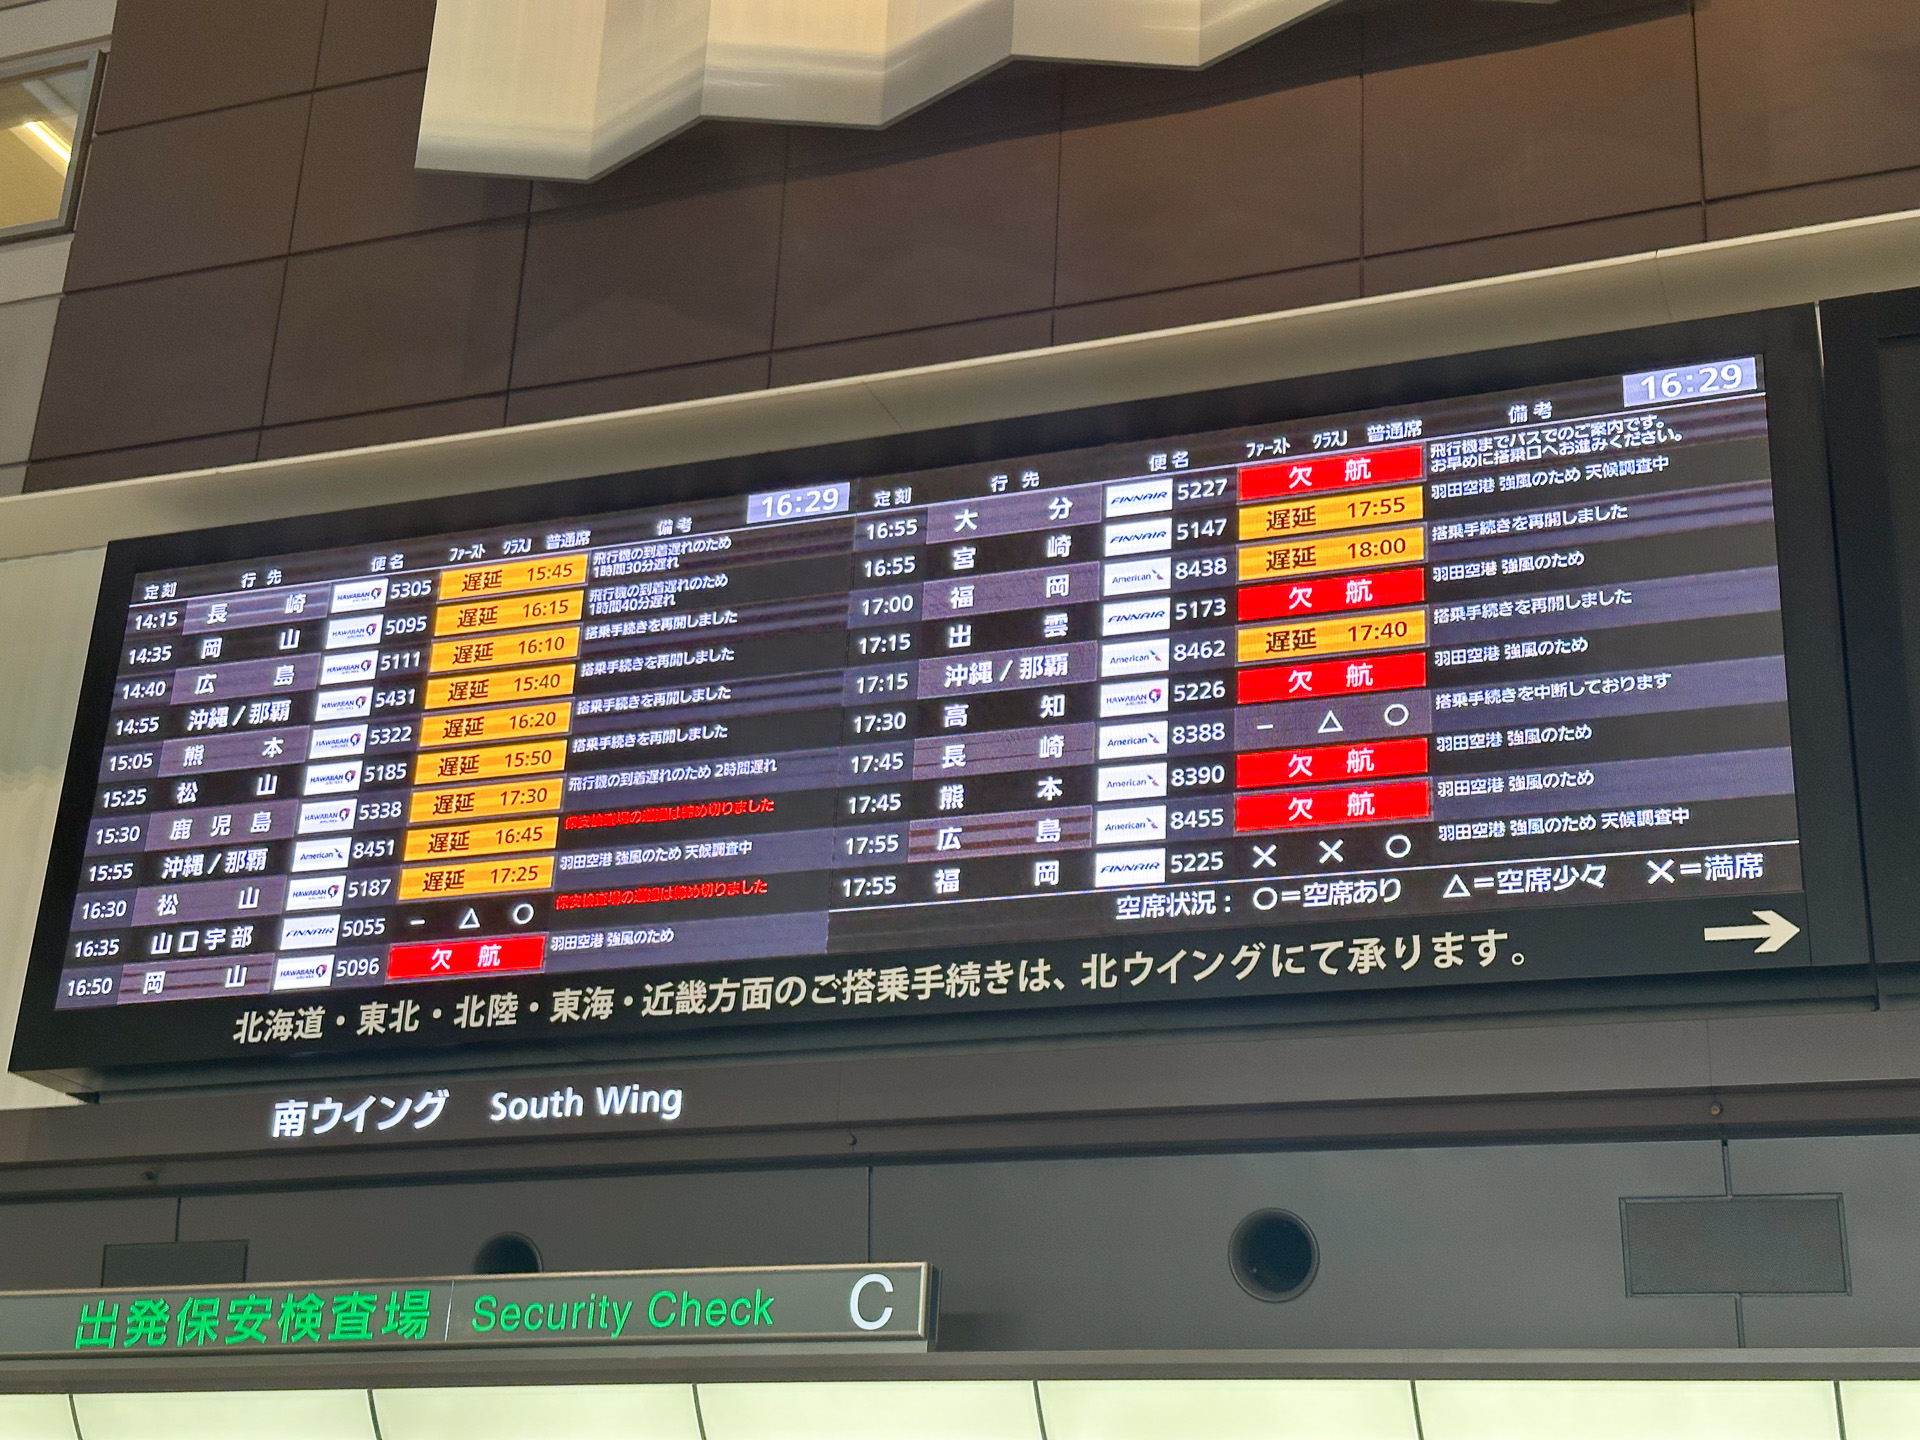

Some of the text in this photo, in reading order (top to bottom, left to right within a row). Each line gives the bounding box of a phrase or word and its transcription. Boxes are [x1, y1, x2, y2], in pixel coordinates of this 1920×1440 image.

[1367, 419, 1422, 442] 普通席
[1640, 363, 1742, 400] 16:29
[546, 531, 591, 550] 普通席
[761, 488, 839, 518] 16:29
[864, 556, 916, 578] 16:55
[1110, 529, 1166, 544] FINNAIR
[1177, 518, 1227, 539] 5147
[1267, 505, 1316, 531] 遅延
[1347, 496, 1406, 518] 17:55
[867, 519, 918, 541] 16:55
[1111, 490, 1168, 504] FINNAIR
[1178, 478, 1227, 499] 5227
[135, 612, 178, 631] 14:15
[391, 581, 432, 599] 5305
[462, 569, 502, 592] 遅延
[527, 563, 573, 581] 15:45
[862, 596, 913, 616] 17:00
[1175, 558, 1227, 579] 8438
[1267, 546, 1316, 571] 遅延
[1347, 538, 1406, 559] 18:00
[129, 646, 172, 664] 14:35
[386, 617, 427, 635] 5095
[458, 606, 498, 628] 遅延
[522, 599, 569, 618] 16:15
[859, 633, 911, 655] 17:15
[1108, 609, 1165, 624] FINNAIR
[1175, 599, 1226, 620] 5173
[122, 681, 166, 699] 14:40
[381, 652, 421, 671] 5111
[452, 642, 494, 664] 遅延
[518, 636, 564, 655] 16:10
[857, 673, 908, 694] 17:15
[1174, 640, 1226, 661] 8462
[1266, 628, 1316, 654] 遅延
[1348, 621, 1408, 642] 17:40
[116, 717, 159, 736] 14:55
[376, 688, 416, 707] 5431
[448, 679, 489, 702] 遅延
[514, 674, 561, 692] 15:40
[854, 712, 906, 733] 17:30
[1173, 681, 1226, 702] 5226
[109, 753, 153, 771] 15:05
[370, 726, 412, 745] 5322
[442, 716, 485, 739] 遅延
[509, 711, 556, 729] 16:20
[851, 752, 903, 774] 17:45
[1107, 735, 1148, 747] American
[1172, 723, 1226, 744] 8388
[102, 789, 146, 808] 15:25
[364, 763, 407, 782] 5185
[438, 754, 480, 778] 遅延
[504, 749, 552, 768] 15:50
[849, 794, 901, 815] 17:45
[1106, 777, 1147, 789] American
[1171, 765, 1225, 787] 8390
[96, 826, 140, 844] 15:30
[359, 801, 401, 821] 5338
[433, 792, 475, 815] 遅延
[500, 788, 548, 807] 17:30
[846, 835, 899, 856] 17:55
[1104, 820, 1146, 831] American
[1170, 808, 1224, 829] 8455
[89, 863, 133, 882] 15:55
[301, 851, 334, 860] American
[353, 839, 395, 859] 8451
[428, 830, 470, 854] 遅延
[495, 826, 543, 845] 16:45
[842, 876, 896, 898] 17:55
[1101, 861, 1160, 874] FINNAIR
[1170, 851, 1224, 873] 5225
[82, 900, 126, 919] 16:30
[348, 879, 391, 898] 5187
[423, 869, 465, 892] 遅延
[490, 865, 538, 884] 17:25
[74, 918, 385, 958] 16:35 山口宇部 FINNAIR 5055
[67, 978, 112, 997] 16:50
[336, 957, 379, 977] 5096
[270, 1083, 684, 1139] 南ウイング South Wing
[75, 1272, 895, 1351] 出発保安検査場 Security Check C
